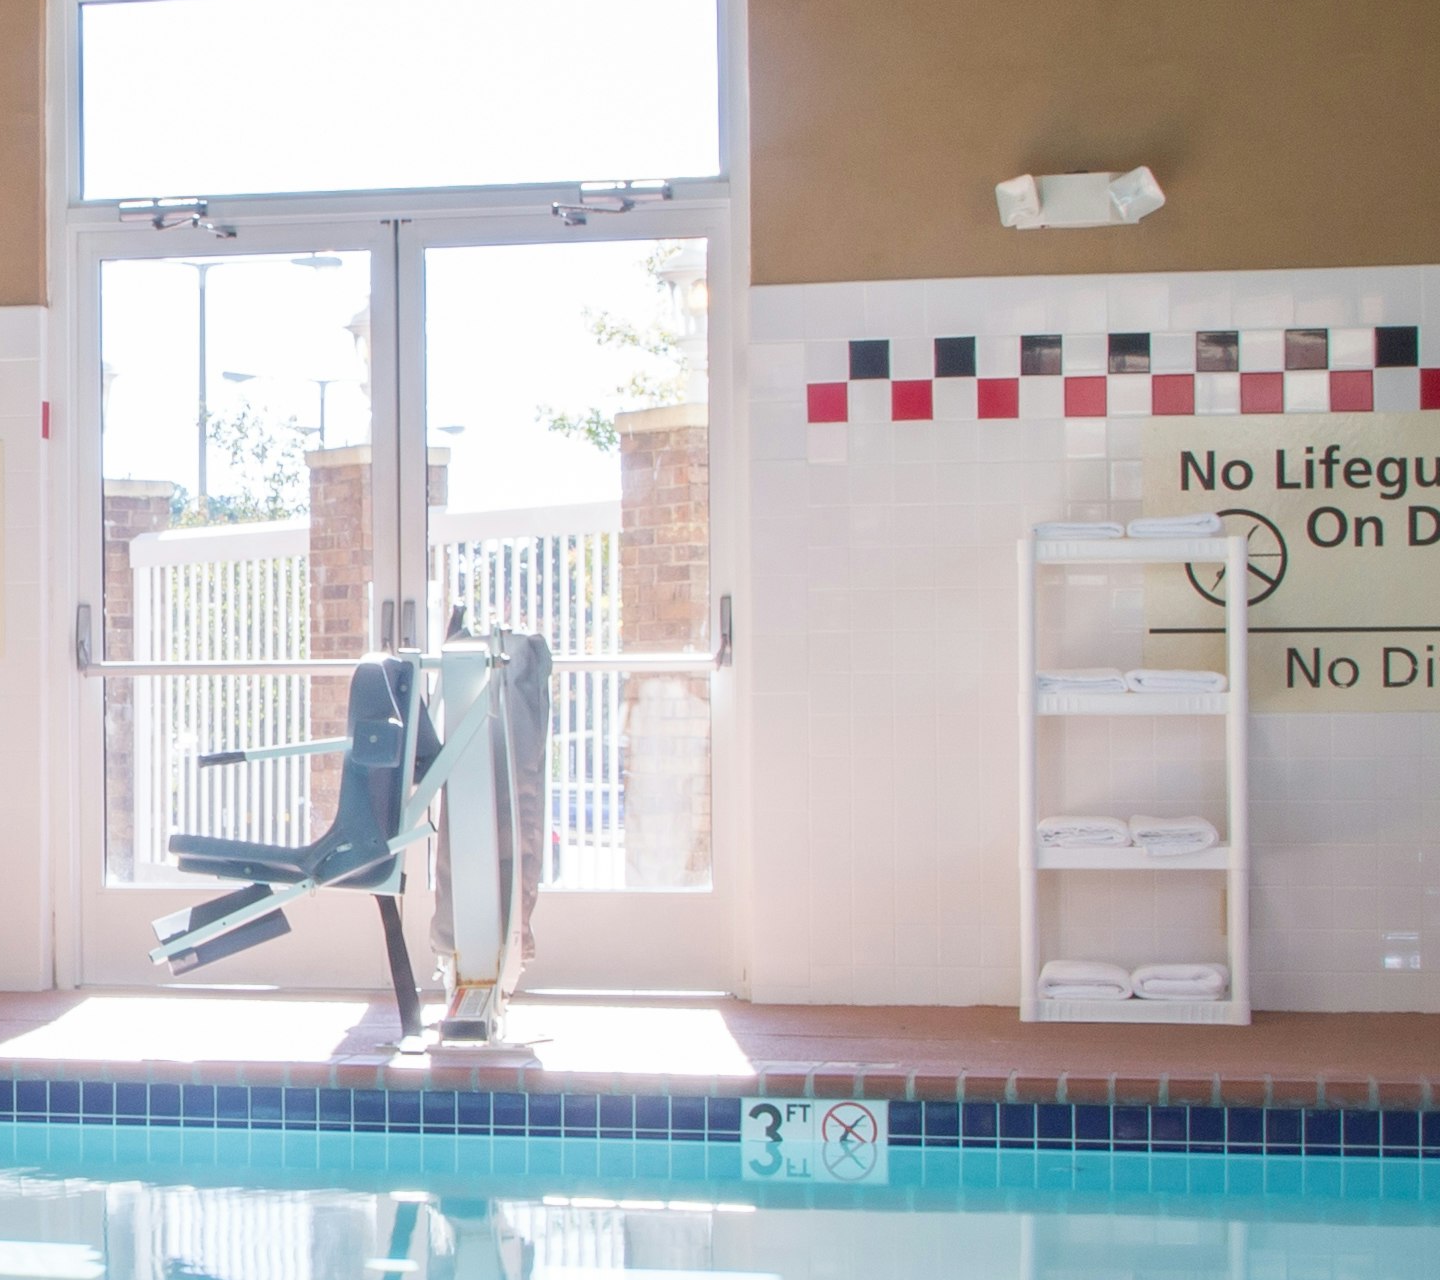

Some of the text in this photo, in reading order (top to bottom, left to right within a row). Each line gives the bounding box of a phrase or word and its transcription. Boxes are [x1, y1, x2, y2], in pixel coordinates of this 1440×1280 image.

[1180, 449, 1254, 491] No
[1306, 505, 1384, 548] On
[1285, 646, 1360, 689] No
[748, 1103, 811, 1142] 3 FT
